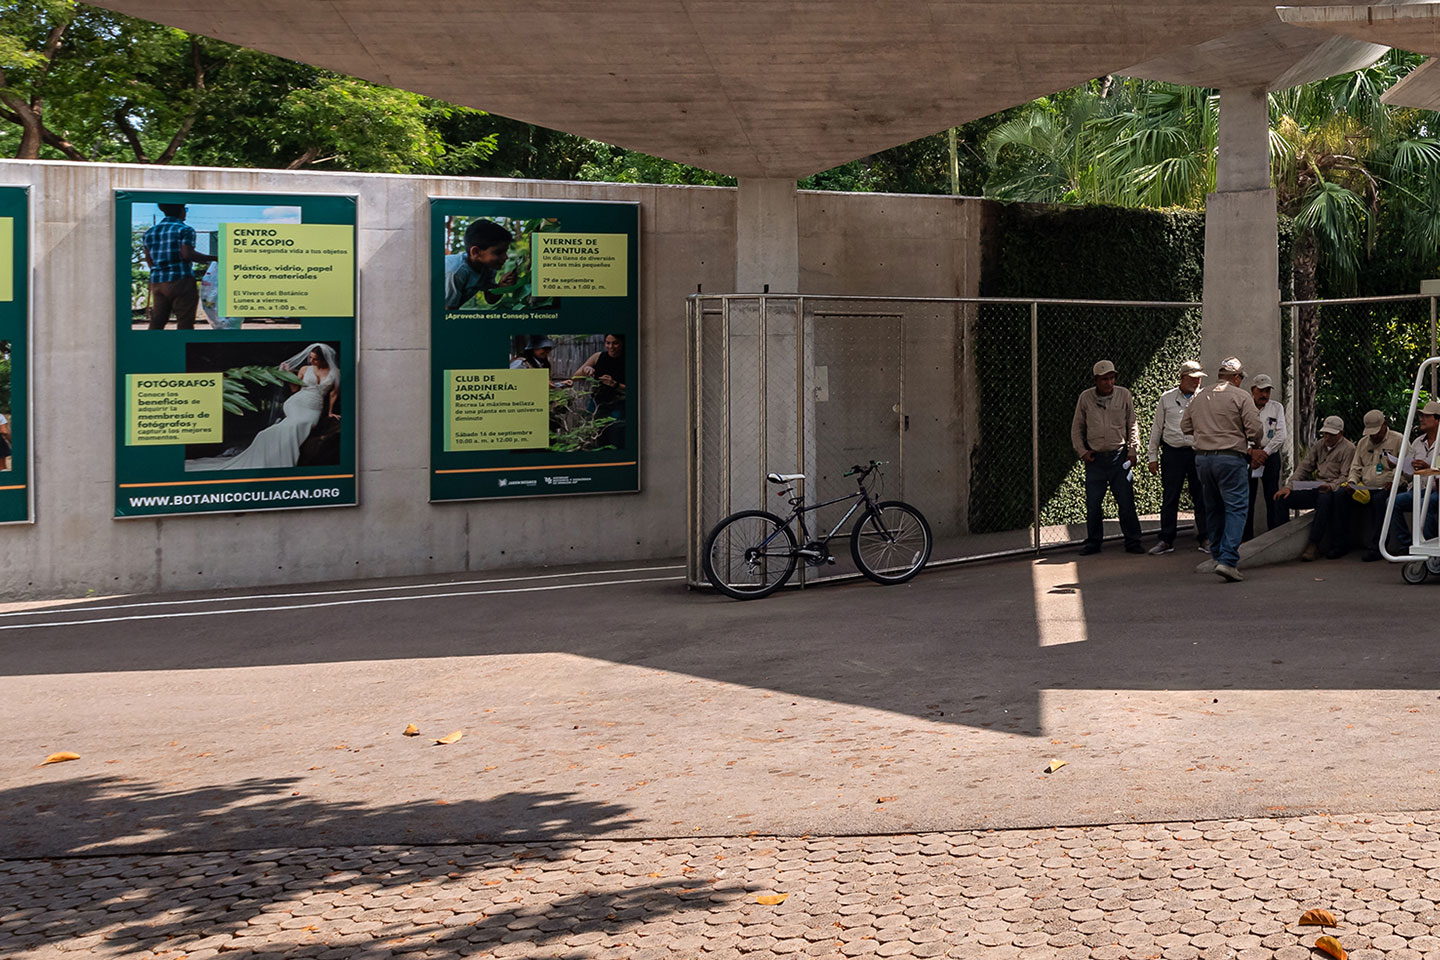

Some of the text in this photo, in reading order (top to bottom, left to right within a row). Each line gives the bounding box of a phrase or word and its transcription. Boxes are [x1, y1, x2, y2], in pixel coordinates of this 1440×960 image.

[233, 229, 277, 237] CENTRO
[251, 239, 295, 247] ACOPIO
[233, 264, 333, 273] Plástico, vidrio, papel
[137, 379, 216, 388] FOTÓGRAFOS
[455, 383, 517, 392] JARDINERÍA:
[455, 392, 495, 401] BONSÁI
[138, 398, 189, 406] beneficios
[138, 420, 191, 429] fotógrafos
[129, 488, 340, 508] WWW.BOTANICOCULIACAN.ORG
